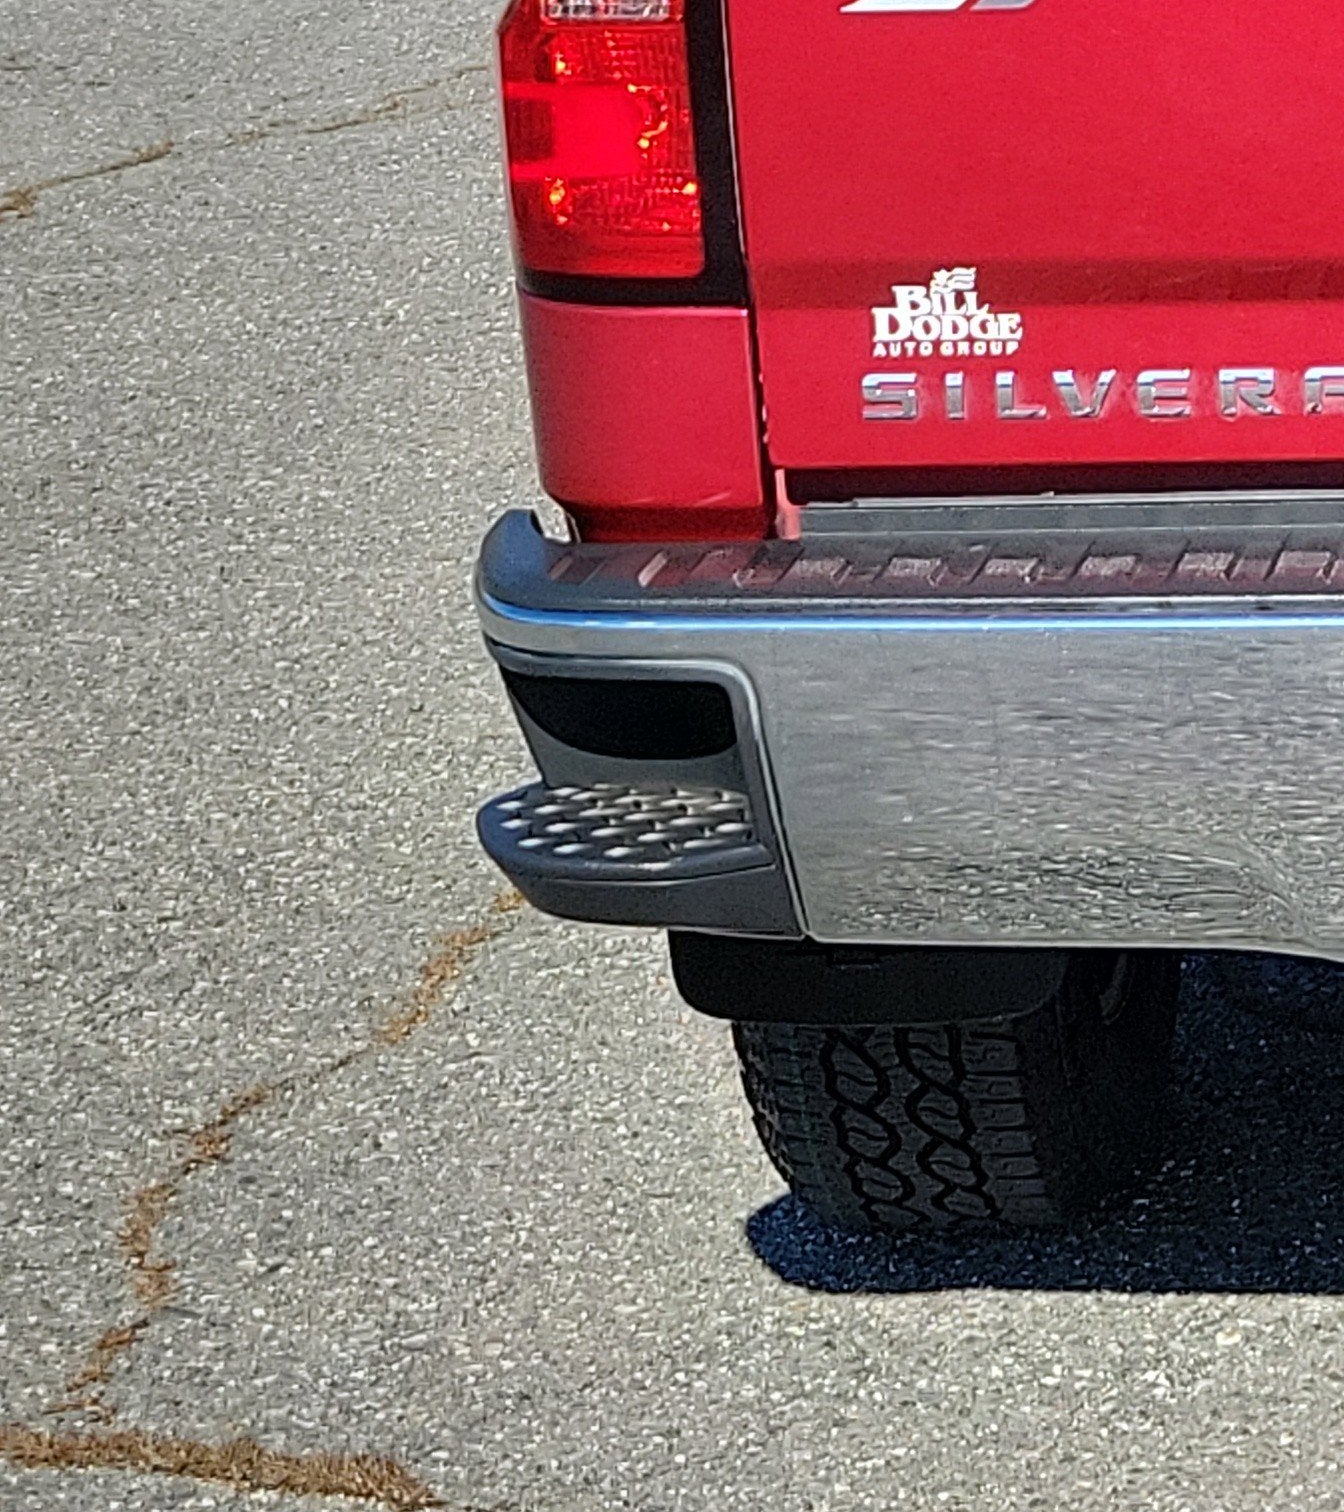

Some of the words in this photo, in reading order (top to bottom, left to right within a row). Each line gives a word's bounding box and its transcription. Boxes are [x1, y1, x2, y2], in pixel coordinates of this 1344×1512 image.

[871, 306, 1024, 342] DODGE
[872, 340, 933, 358] AUTO
[939, 340, 1020, 358] GROUP
